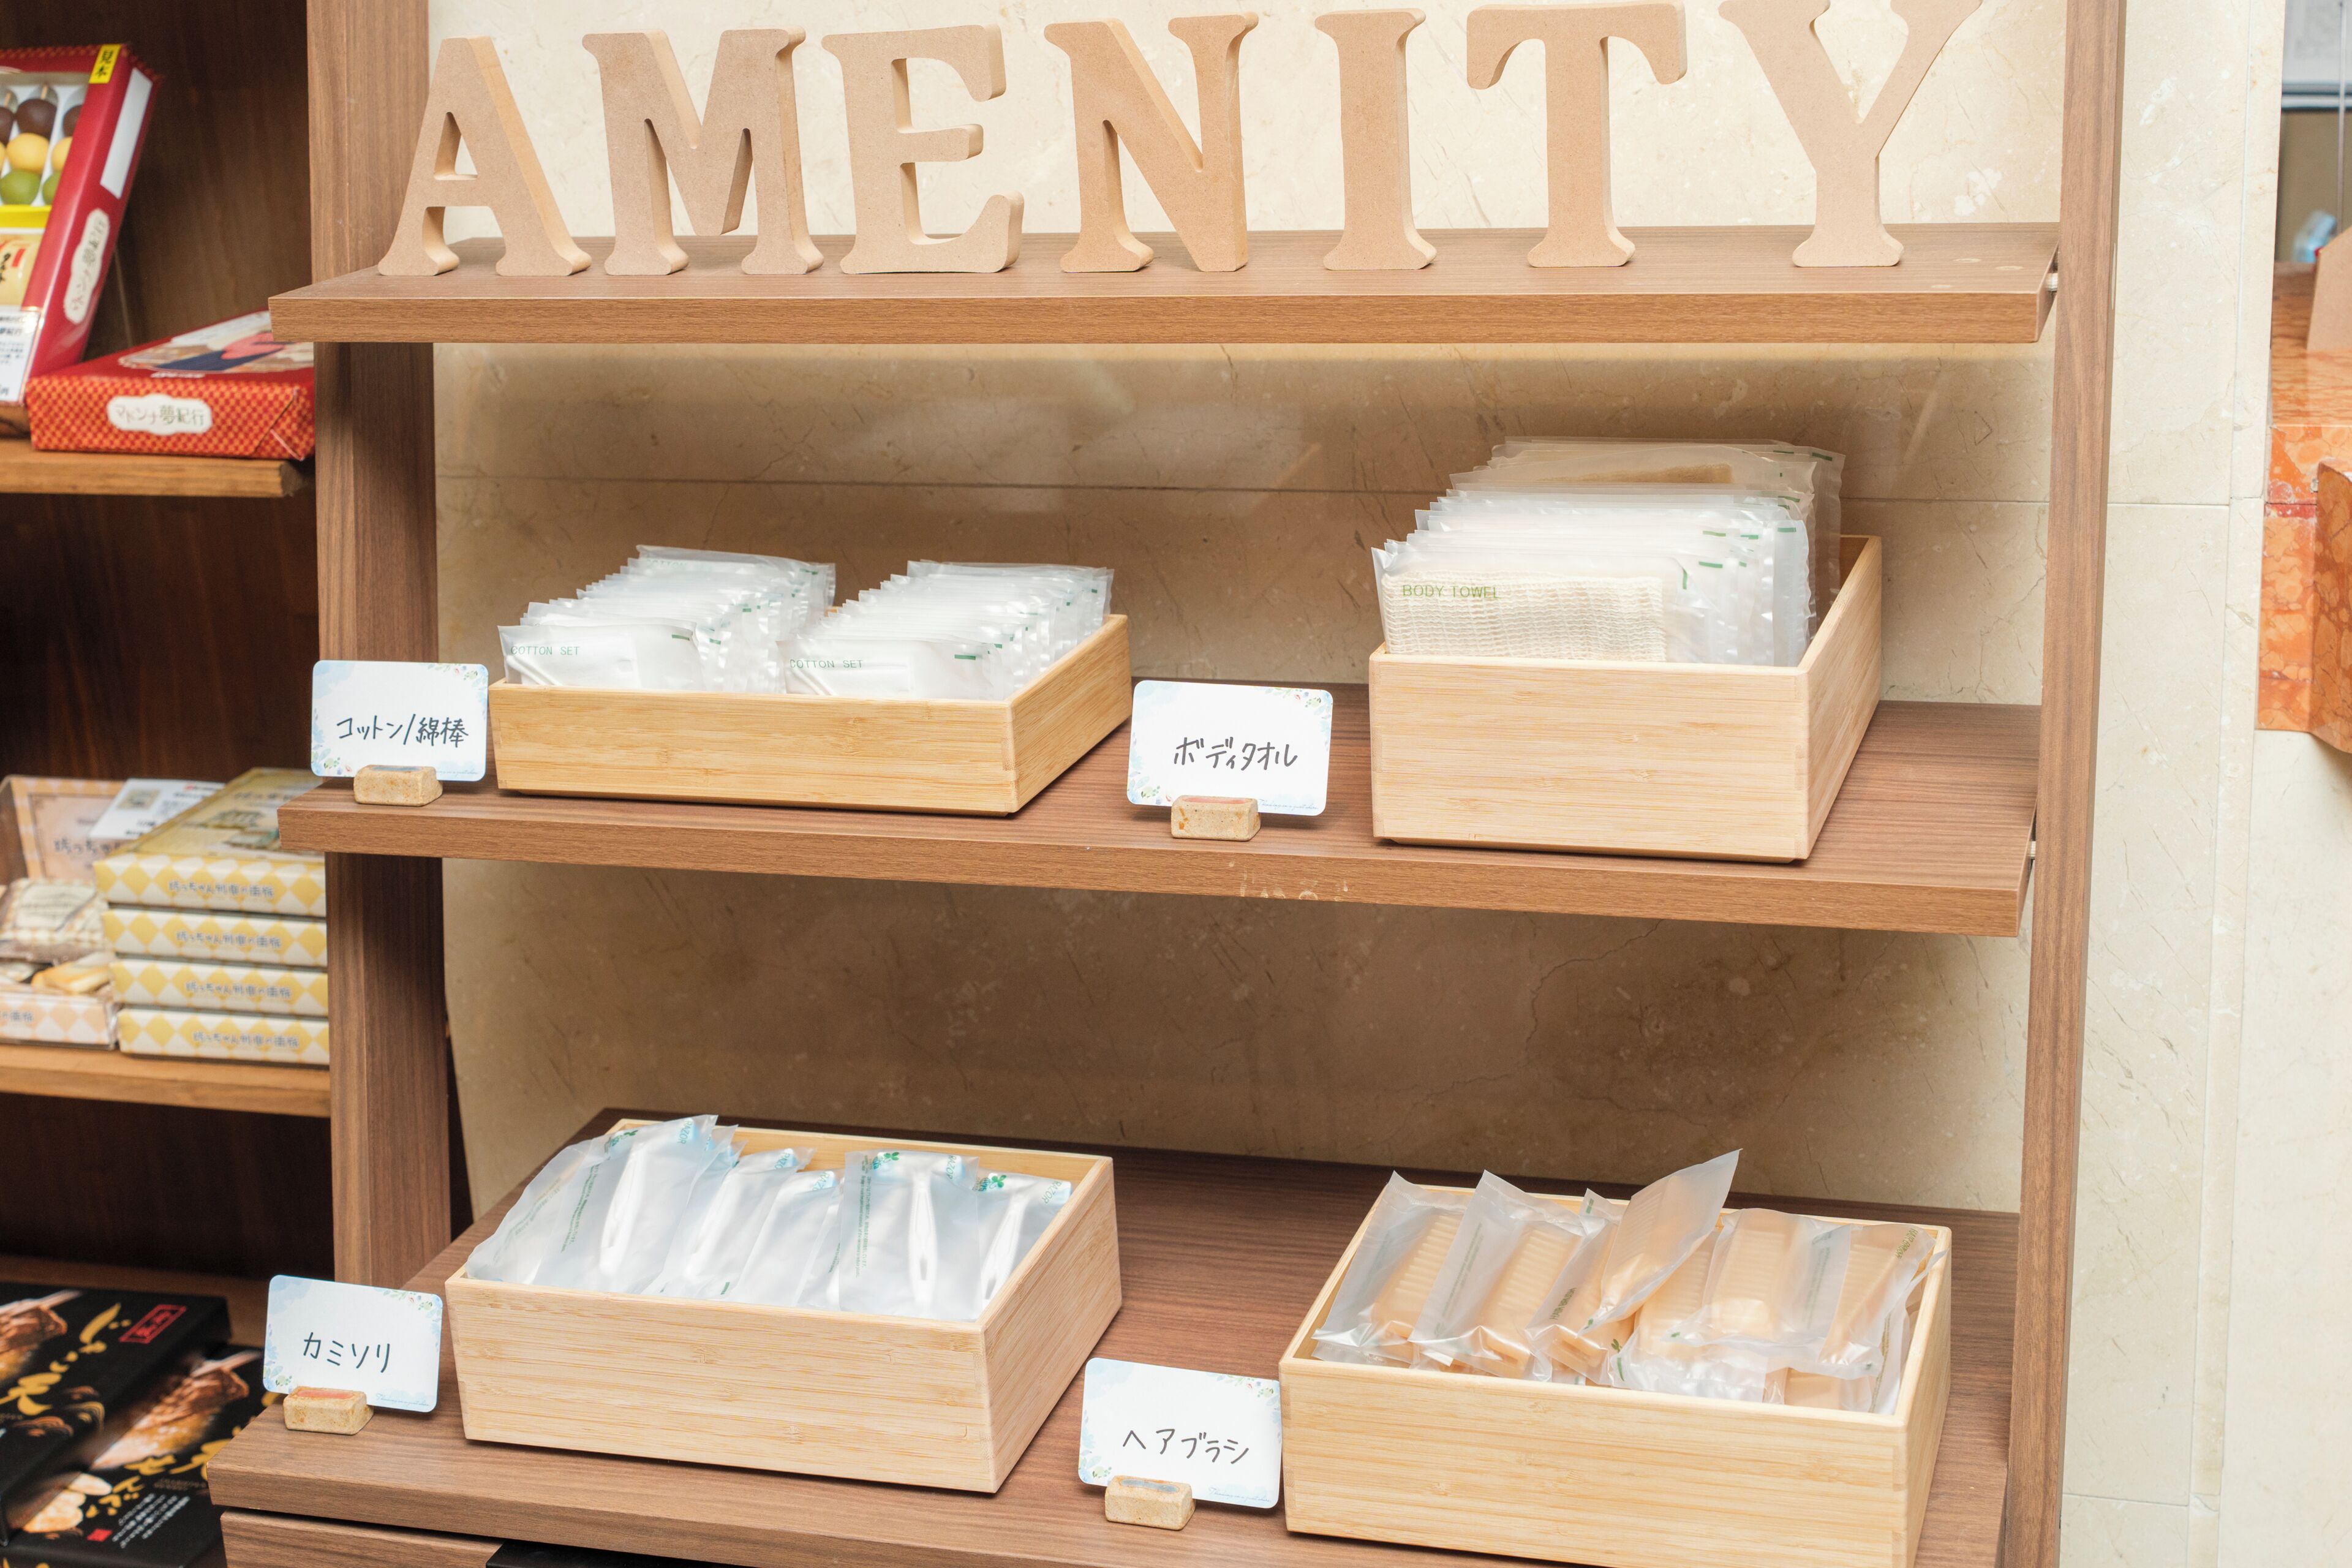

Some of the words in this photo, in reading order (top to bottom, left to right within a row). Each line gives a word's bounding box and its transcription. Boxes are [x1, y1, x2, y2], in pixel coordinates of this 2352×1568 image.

[378, 0, 1980, 277] AMENITY
[1403, 585, 1444, 597] BODY
[1450, 586, 1500, 598] TOWEL
[510, 646, 552, 655] COTTON
[560, 647, 580, 655] SET
[790, 659, 835, 668] COTTON
[843, 660, 864, 668] SET
[336, 714, 469, 748] コットン/綿棒
[1174, 737, 1298, 771] ボディタオル
[677, 1120, 692, 1144] RAZOR
[946, 1155, 957, 1180] RAZOR
[1041, 1180, 1062, 1204] RAZOR
[303, 1332, 390, 1373] カミソリ
[1122, 1428, 1250, 1464] ヘアブラシ
